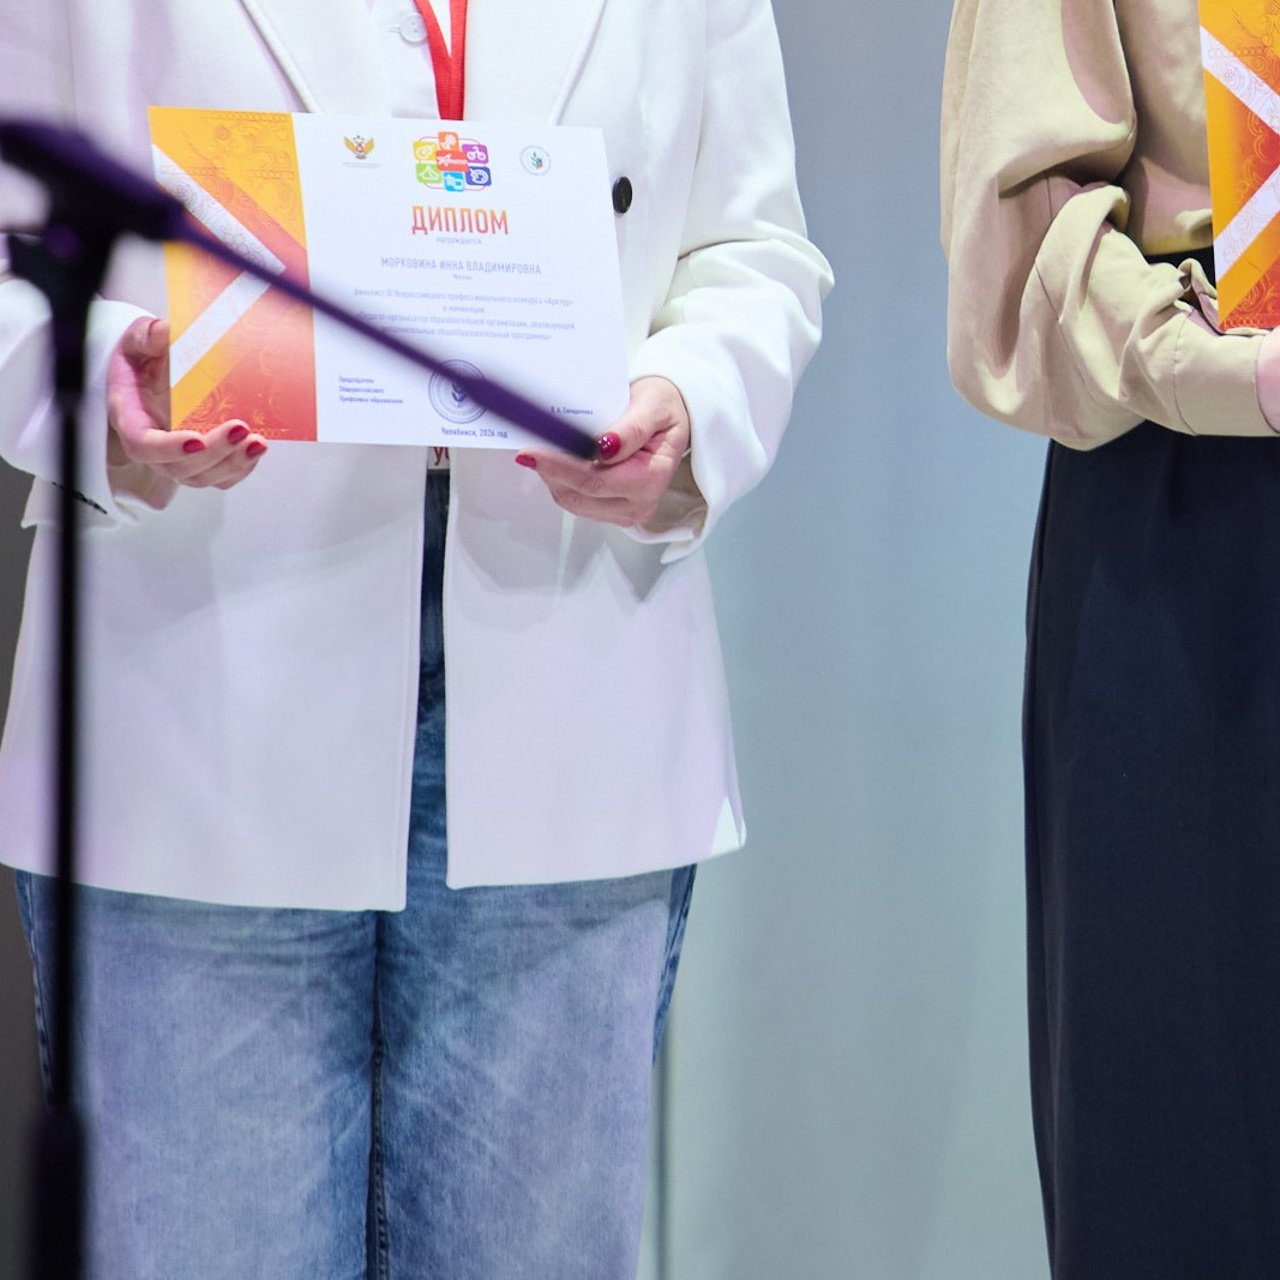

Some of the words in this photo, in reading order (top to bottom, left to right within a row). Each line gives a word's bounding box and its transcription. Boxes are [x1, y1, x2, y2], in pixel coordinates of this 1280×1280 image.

[412, 205, 509, 236] ДИПЛОМ
[381, 257, 438, 270] МОРКОВИНА
[439, 259, 464, 271] ИННА
[466, 260, 542, 275] ВЛАДИМИРОВНА
